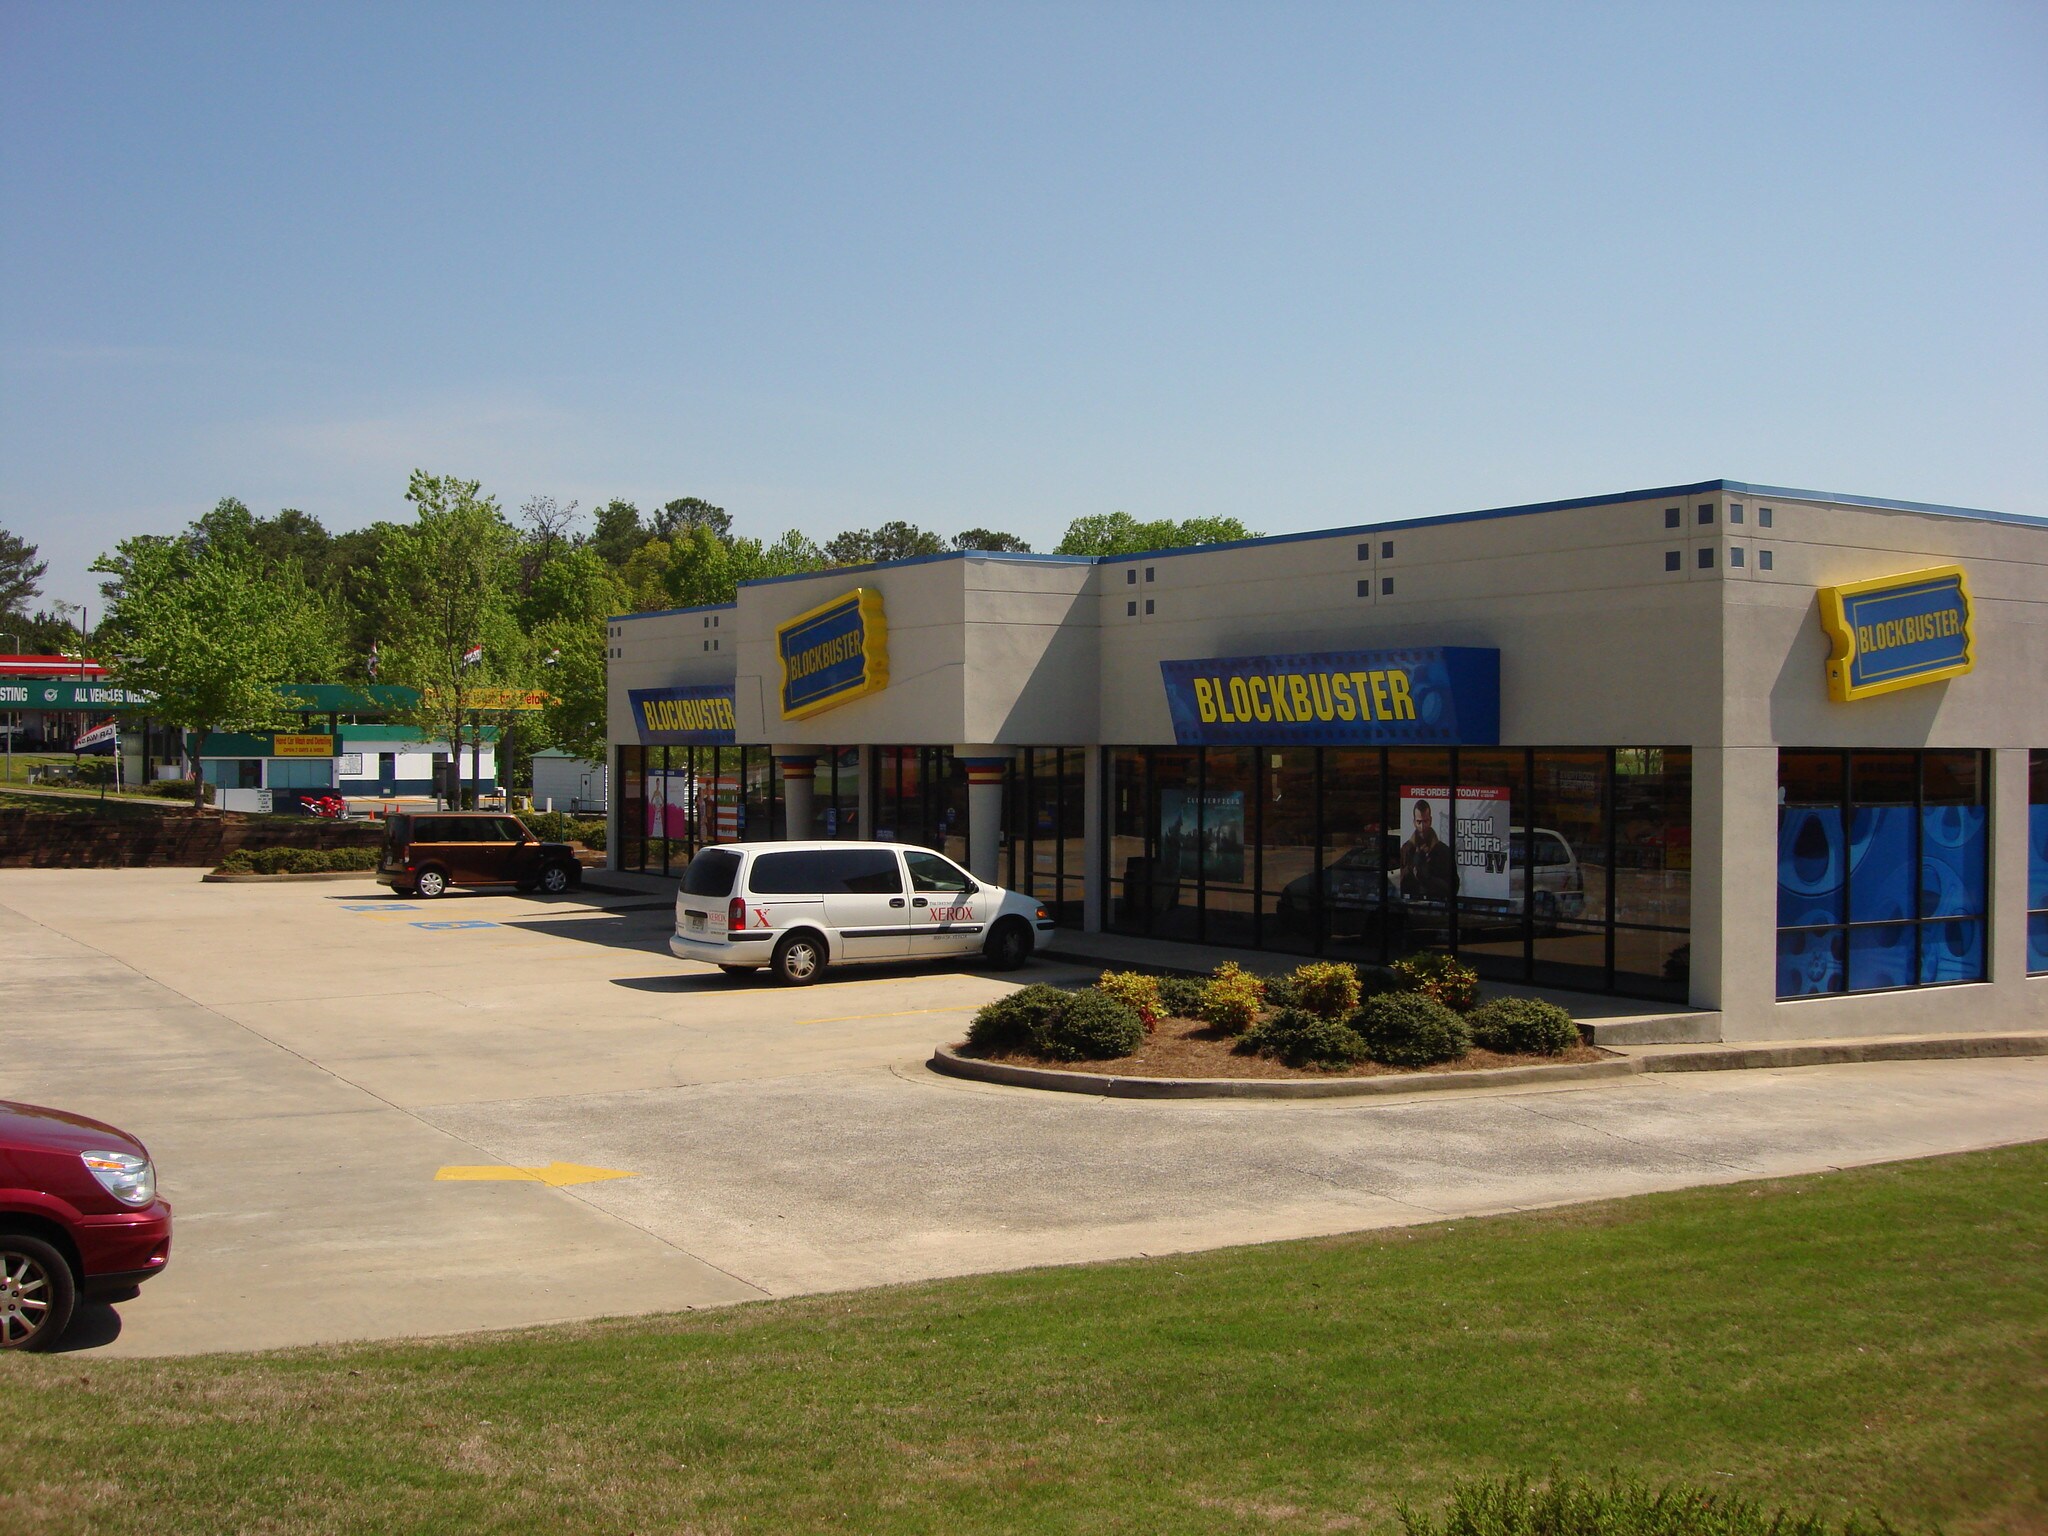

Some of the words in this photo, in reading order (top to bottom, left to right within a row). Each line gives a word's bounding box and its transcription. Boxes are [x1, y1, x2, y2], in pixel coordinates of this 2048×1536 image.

[1859, 609, 1960, 654] BLOCKBUSTER
[790, 629, 861, 681] BLOCKBUSTER
[74, 688, 88, 702] ALL
[89, 688, 123, 703] VEHICLES
[126, 689, 161, 703] WELC
[1193, 670, 1416, 723] BLOCKBUSTER
[642, 698, 736, 731] BLOCKBUSTER
[276, 737, 287, 745] Hand
[295, 737, 305, 745] Wash
[1456, 788, 1480, 797] TODAY
[1463, 836, 1501, 851] theft
[1457, 852, 1486, 866] auto
[1485, 852, 1508, 874] IV
[753, 908, 773, 928] X
[929, 907, 973, 921] XEROX
